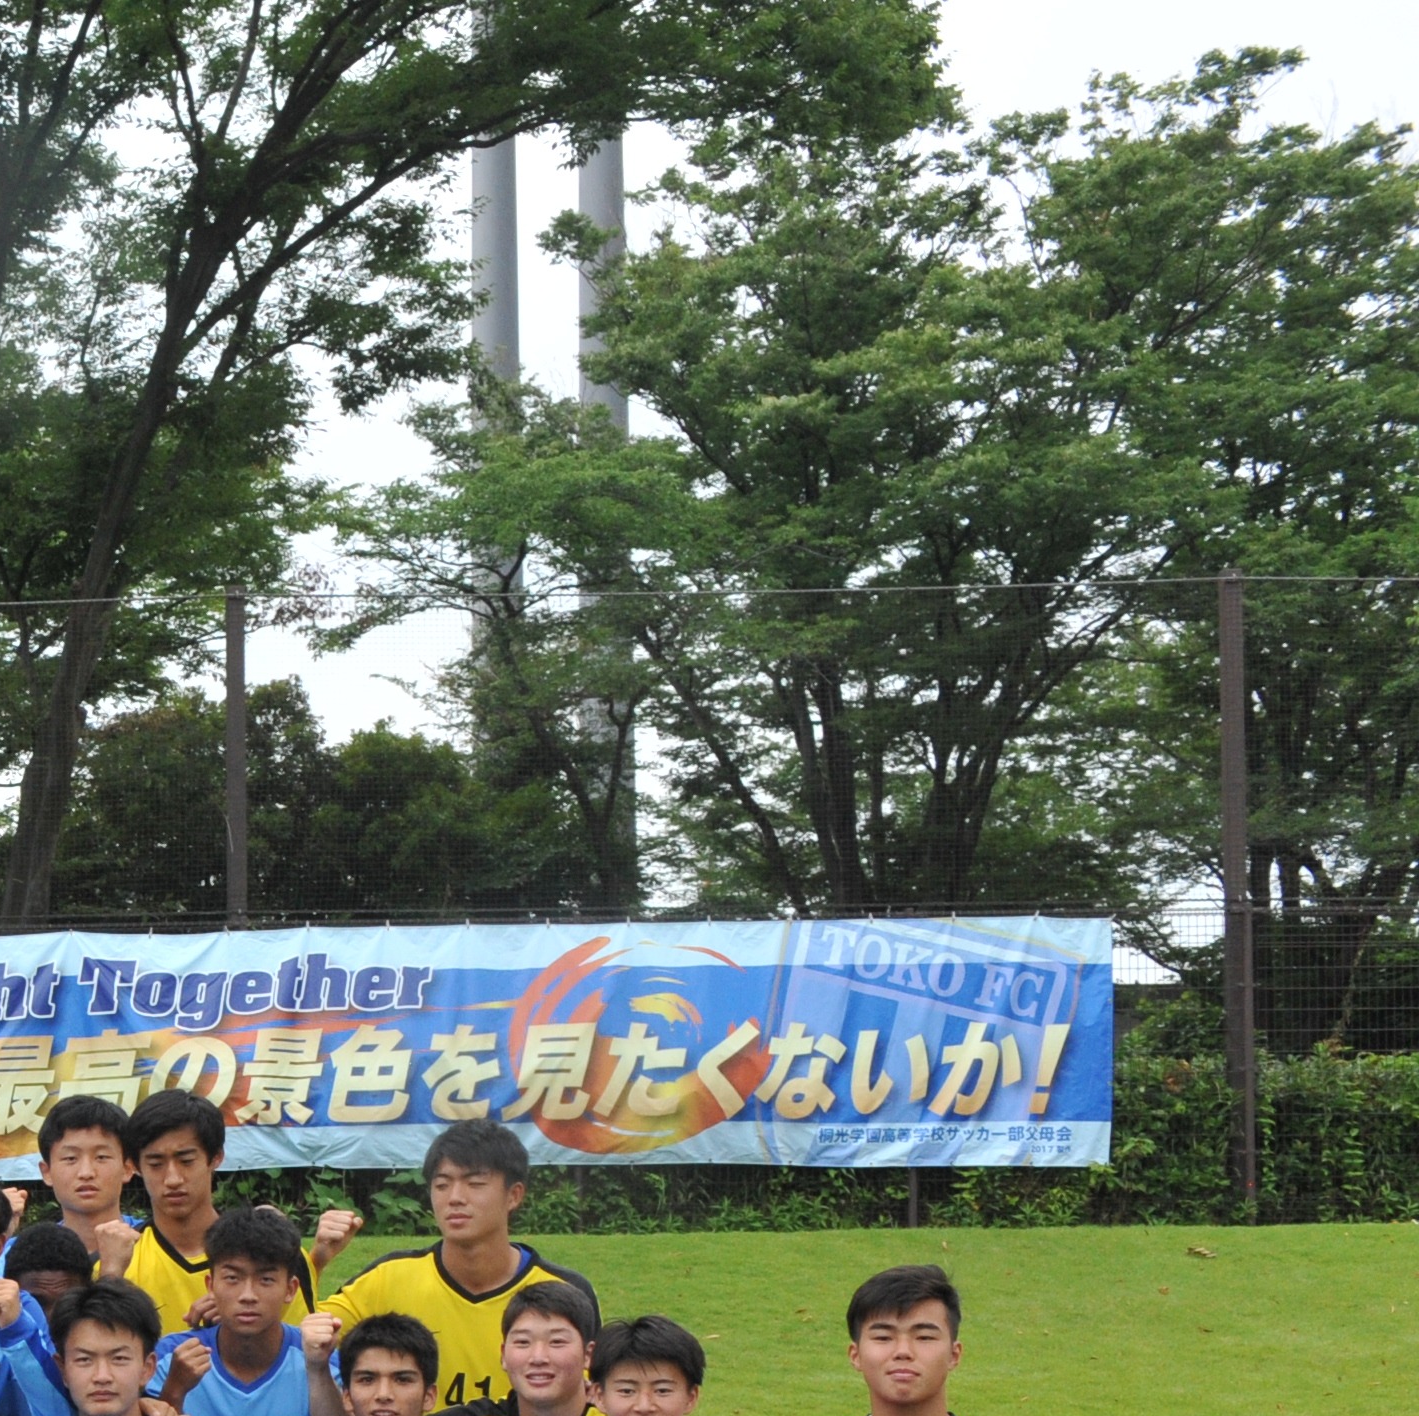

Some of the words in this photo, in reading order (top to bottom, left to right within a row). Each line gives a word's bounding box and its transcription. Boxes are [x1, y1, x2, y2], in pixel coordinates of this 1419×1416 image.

[77, 952, 434, 1031] Together
[820, 928, 965, 999] TOKO
[980, 964, 1044, 1019] FC
